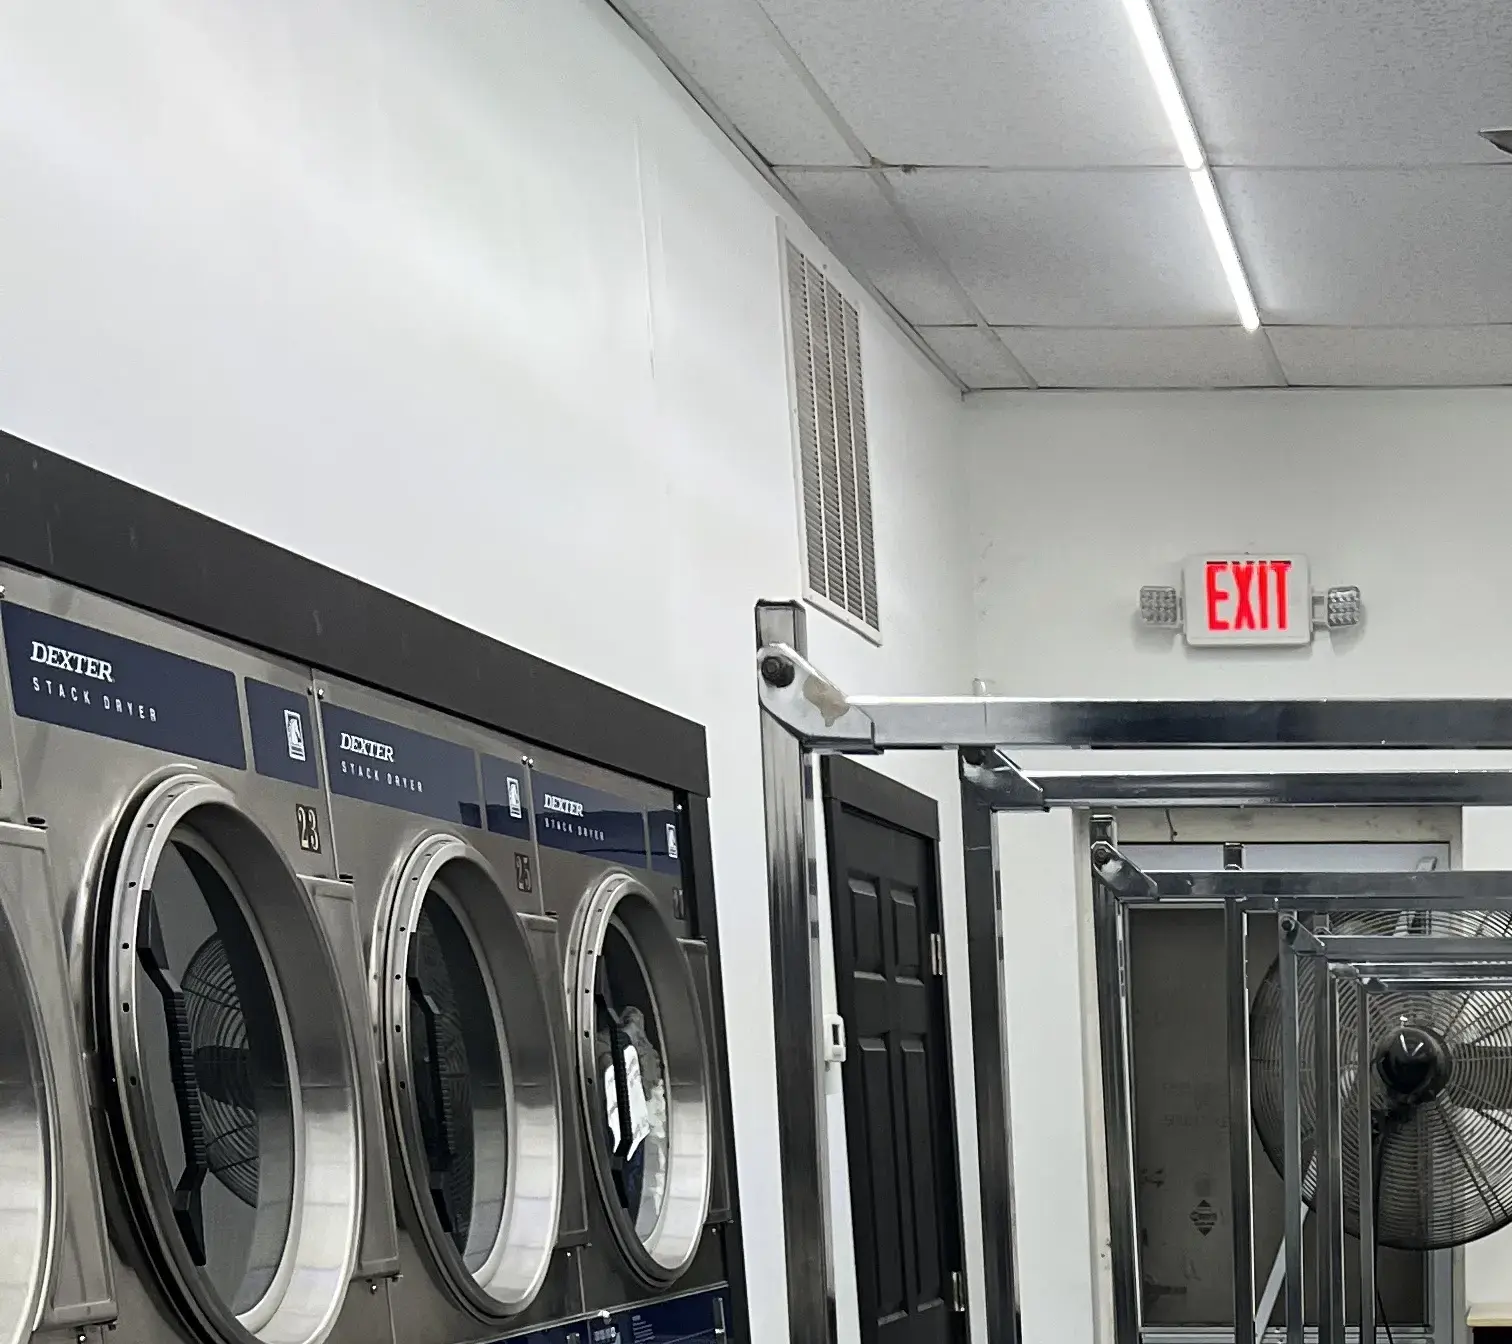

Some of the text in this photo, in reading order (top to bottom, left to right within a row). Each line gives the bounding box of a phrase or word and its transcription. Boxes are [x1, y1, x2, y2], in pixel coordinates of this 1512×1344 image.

[1204, 560, 1293, 632] EXIT
[30, 641, 114, 684] DEXTER
[33, 677, 158, 722] STACK DRYER
[340, 732, 395, 763] DEXTER
[342, 761, 423, 793] STACK DRYER
[544, 793, 584, 817] DEXTER
[297, 806, 319, 851] 23
[515, 854, 532, 892] 25
